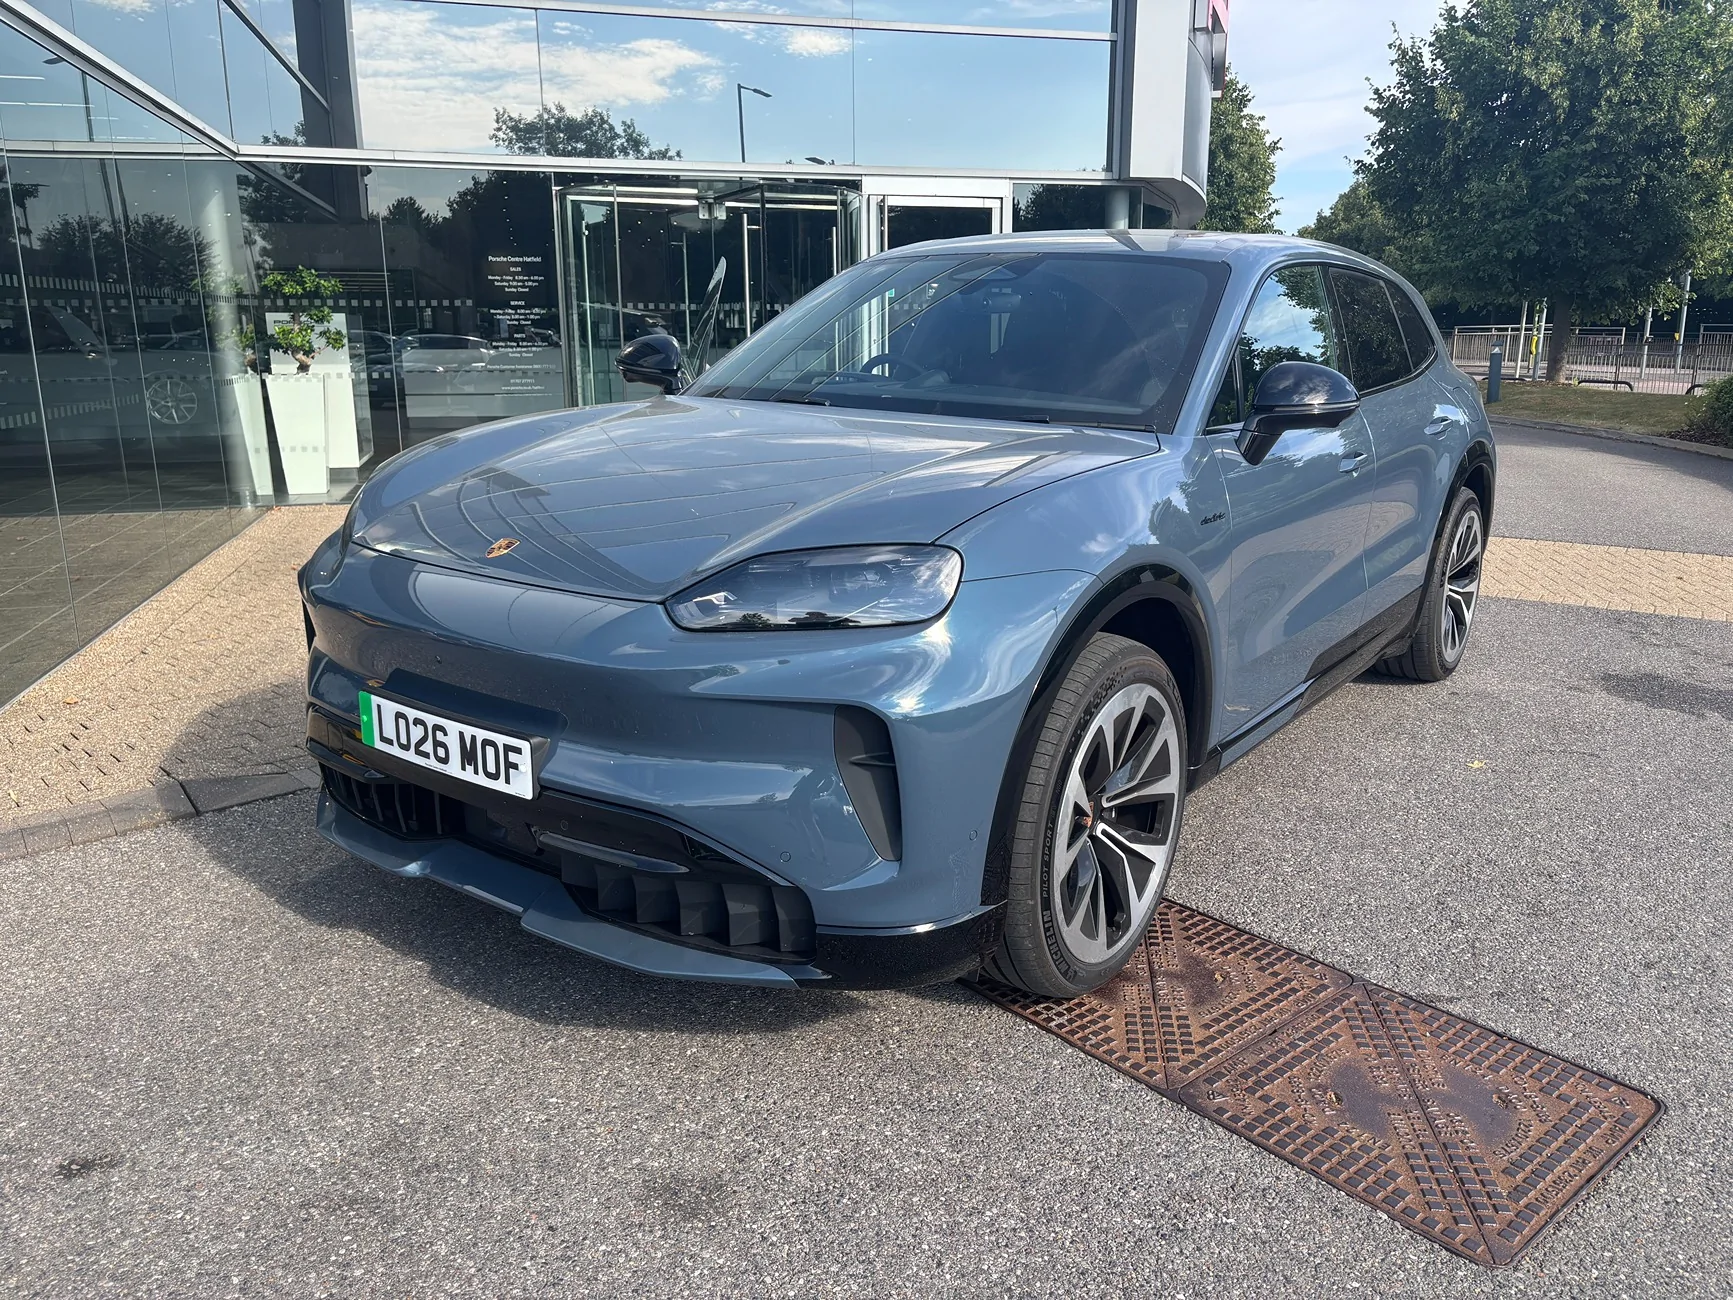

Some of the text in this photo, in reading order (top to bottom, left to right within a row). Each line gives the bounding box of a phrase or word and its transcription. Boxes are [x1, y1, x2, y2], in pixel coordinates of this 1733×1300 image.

[376, 704, 523, 786] LO26 MOF
[1044, 821, 1054, 862] SPORT
[1042, 909, 1070, 978] MICHELIN
